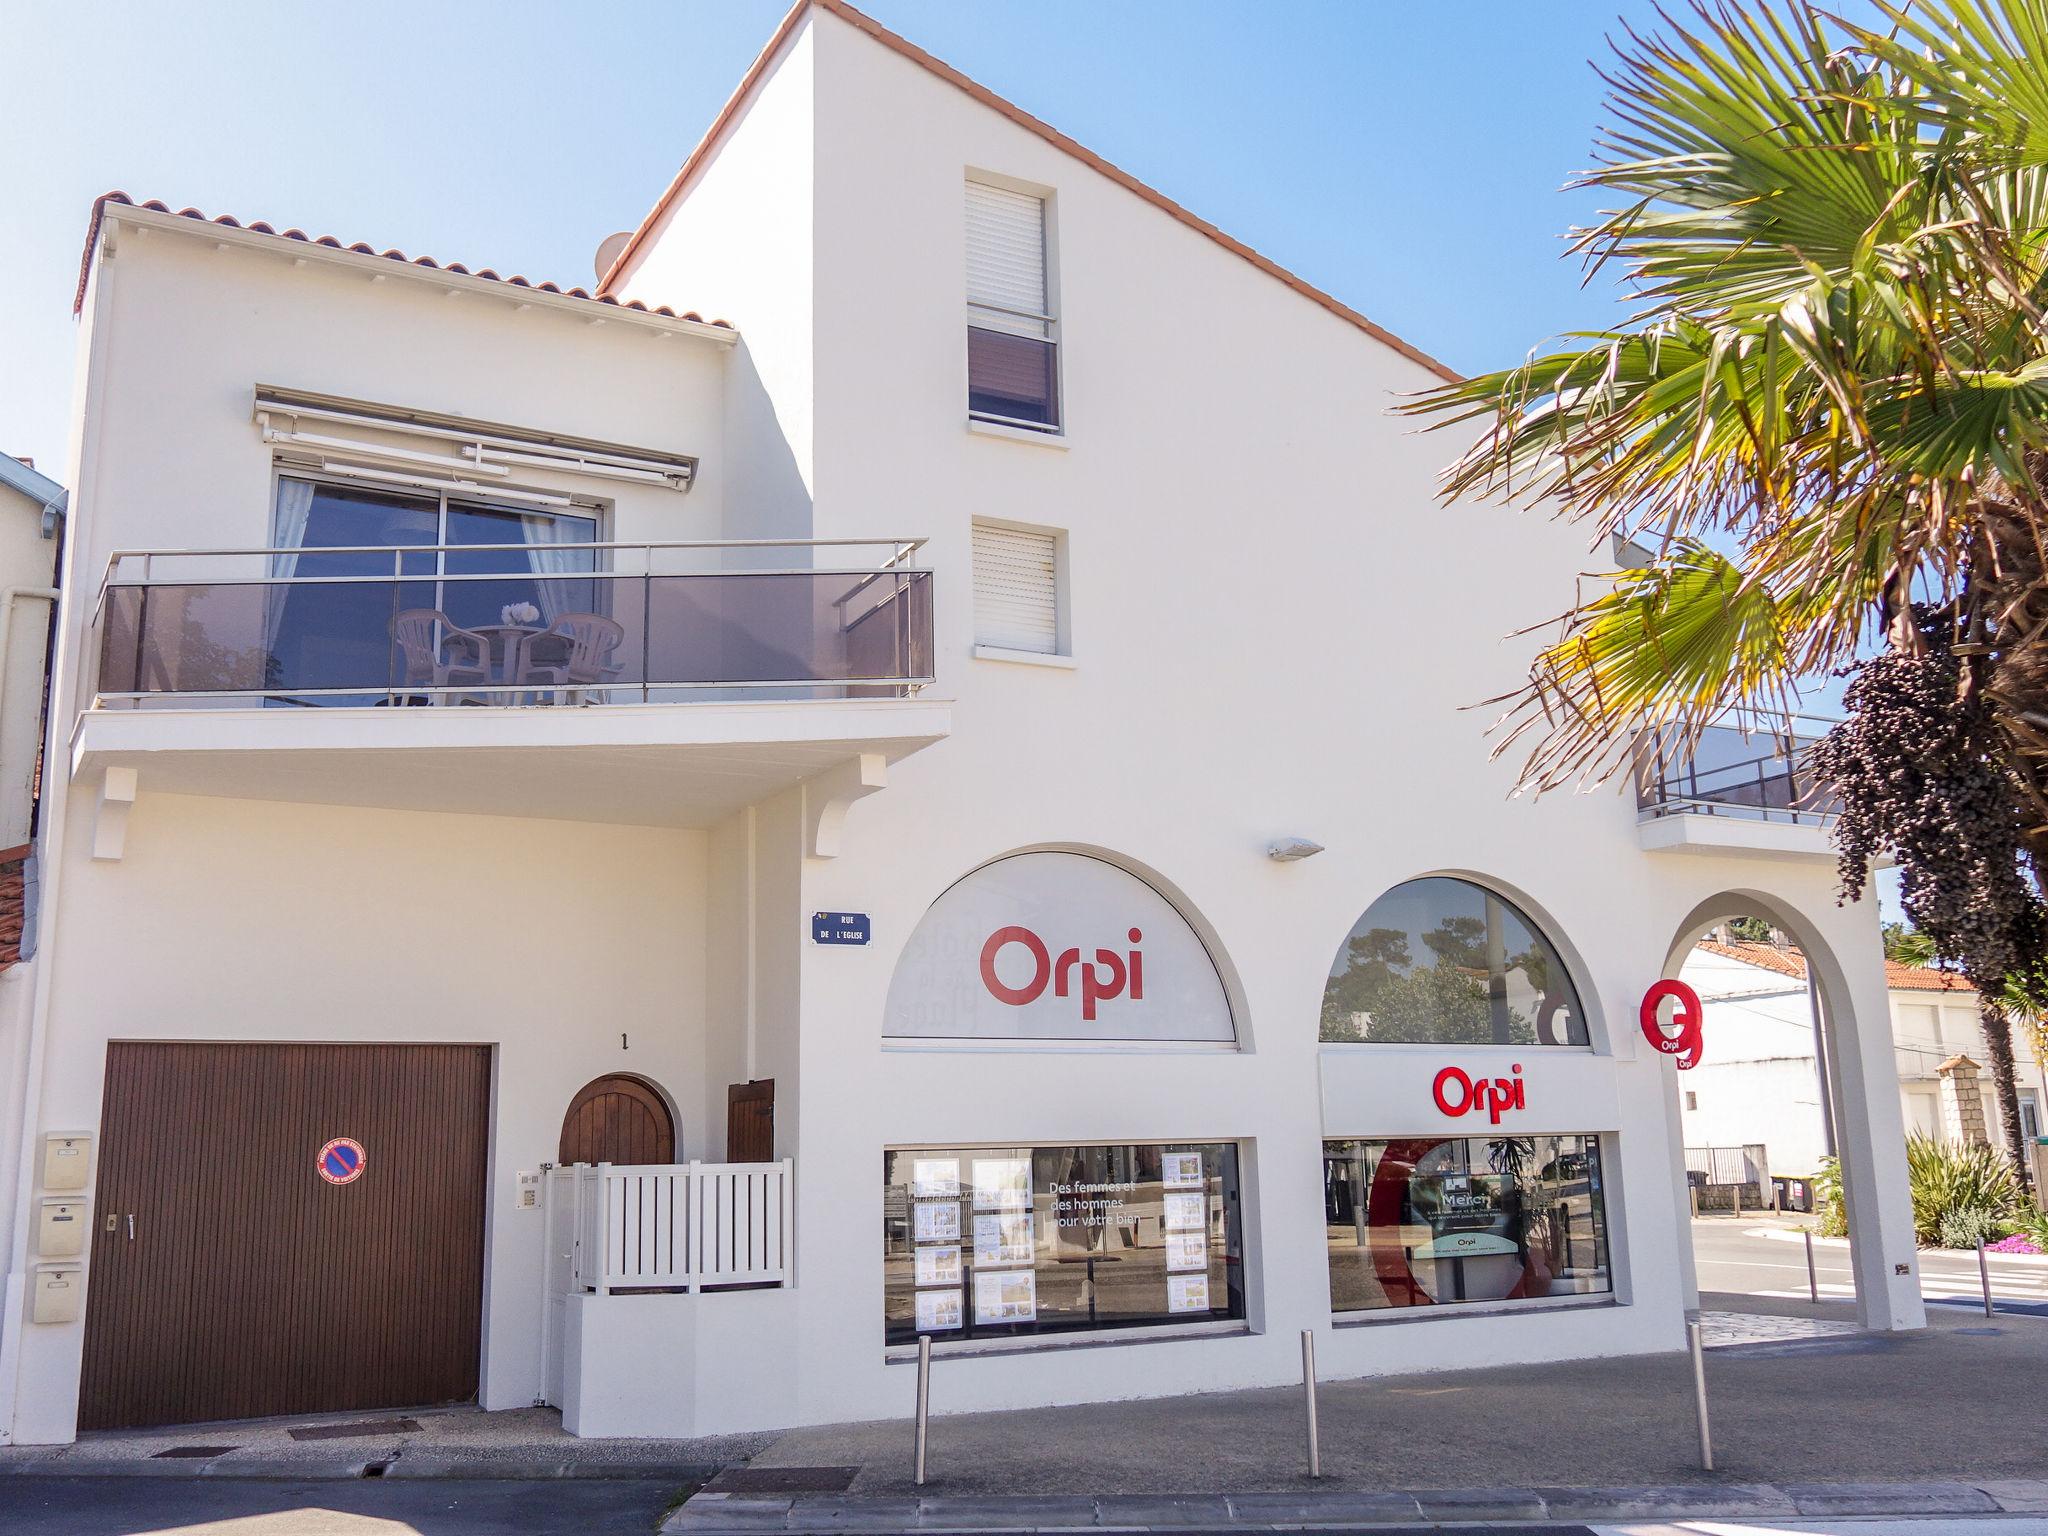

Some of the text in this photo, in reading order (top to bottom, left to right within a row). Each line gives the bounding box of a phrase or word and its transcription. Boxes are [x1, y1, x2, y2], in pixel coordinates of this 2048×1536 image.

[841, 916, 854, 924] RUE
[836, 931, 863, 939] L'EGLISE
[980, 926, 1143, 1020] Orpi
[621, 1033, 629, 1050] 1
[1661, 1040, 1679, 1051] Orpi
[1679, 1060, 1693, 1069] Orpi
[1433, 1064, 1525, 1124] Orpi
[1050, 1180, 1136, 1194] Des femmes et
[1050, 1198, 1124, 1210] des hommes
[1442, 1193, 1486, 1206] Merci
[1082, 1214, 1113, 1226] votre
[1116, 1212, 1141, 1225] bien
